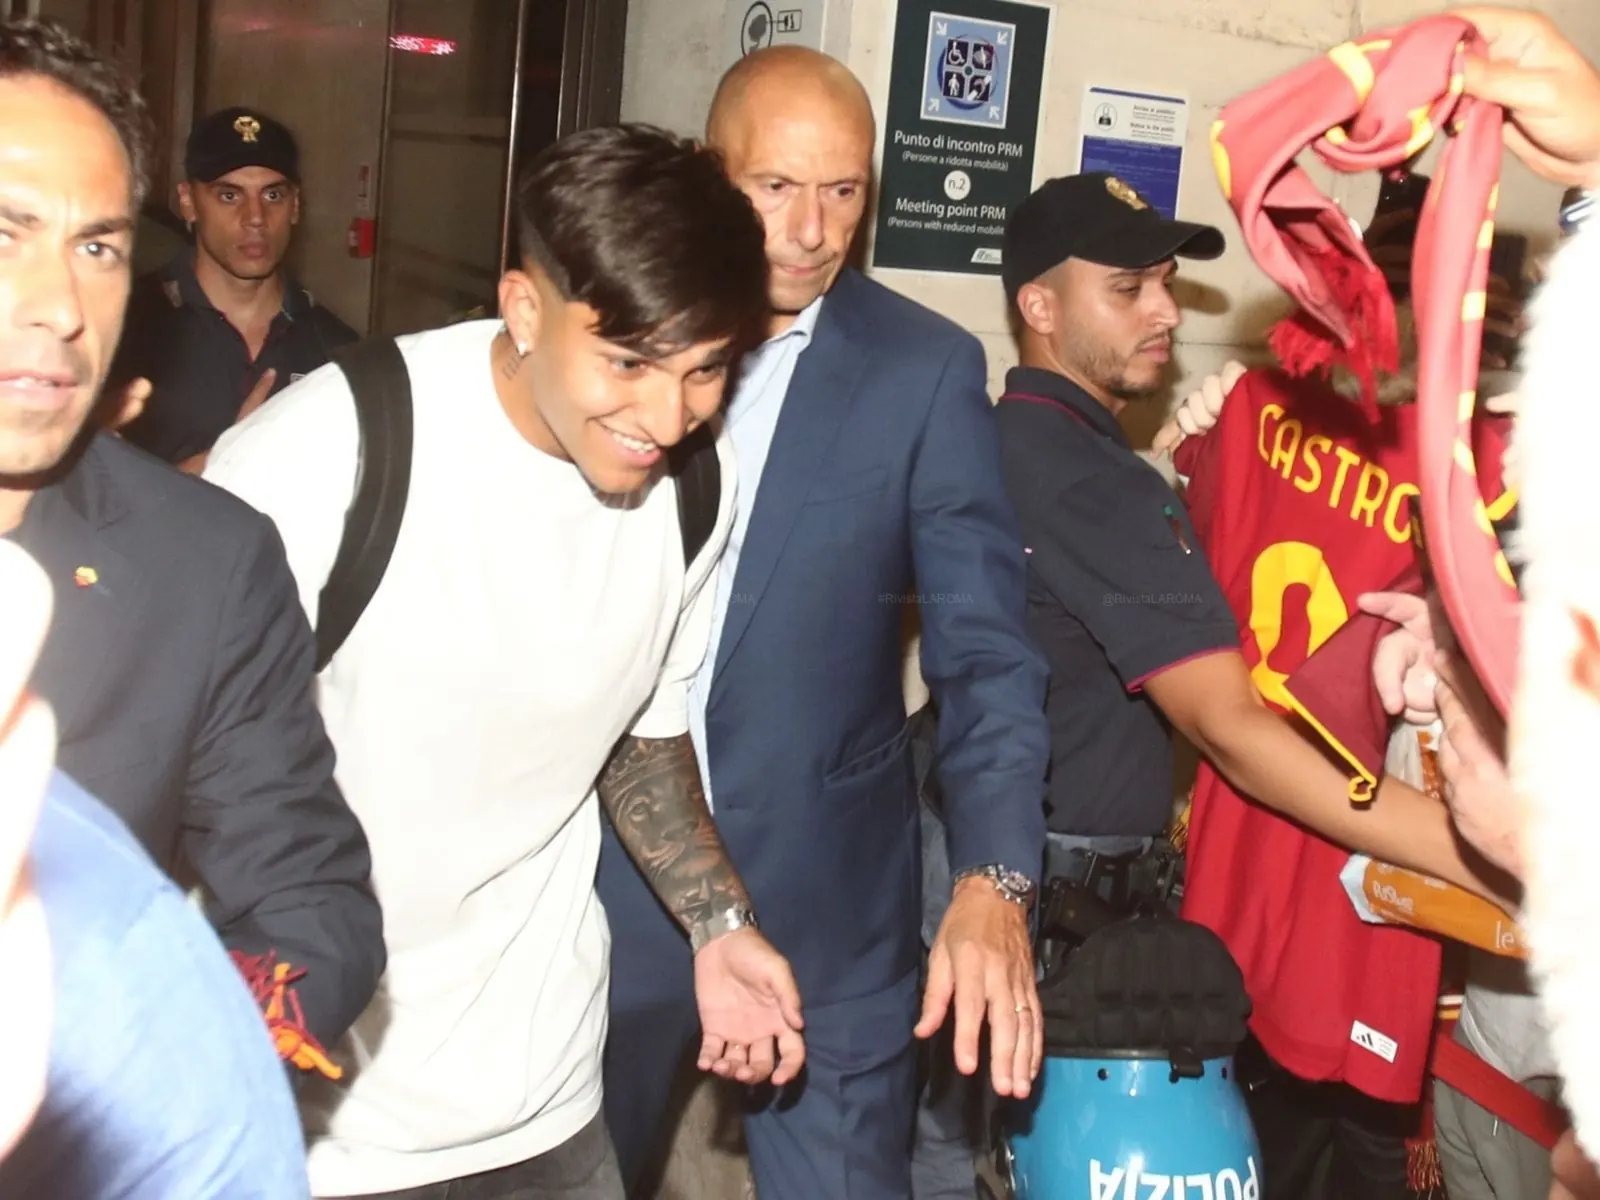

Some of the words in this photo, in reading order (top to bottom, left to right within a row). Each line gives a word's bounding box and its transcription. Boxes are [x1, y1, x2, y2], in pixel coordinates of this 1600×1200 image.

[894, 130, 930, 147] Punto
[933, 134, 944, 149] di
[947, 136, 995, 154] incontro
[998, 142, 1023, 157] PRM
[902, 150, 938, 163] (Persone
[940, 156, 944, 164] a
[946, 155, 972, 167] ridotta
[948, 178, 966, 190] n.2
[895, 198, 944, 218] Meeting
[947, 203, 978, 218] point
[980, 205, 1006, 220] PRM
[887, 216, 922, 229] (Persons
[924, 220, 942, 230] with
[943, 222, 976, 233] reduced
[977, 225, 1005, 235] mobilit
[1089, 1154, 1260, 1200] POLIZIA
